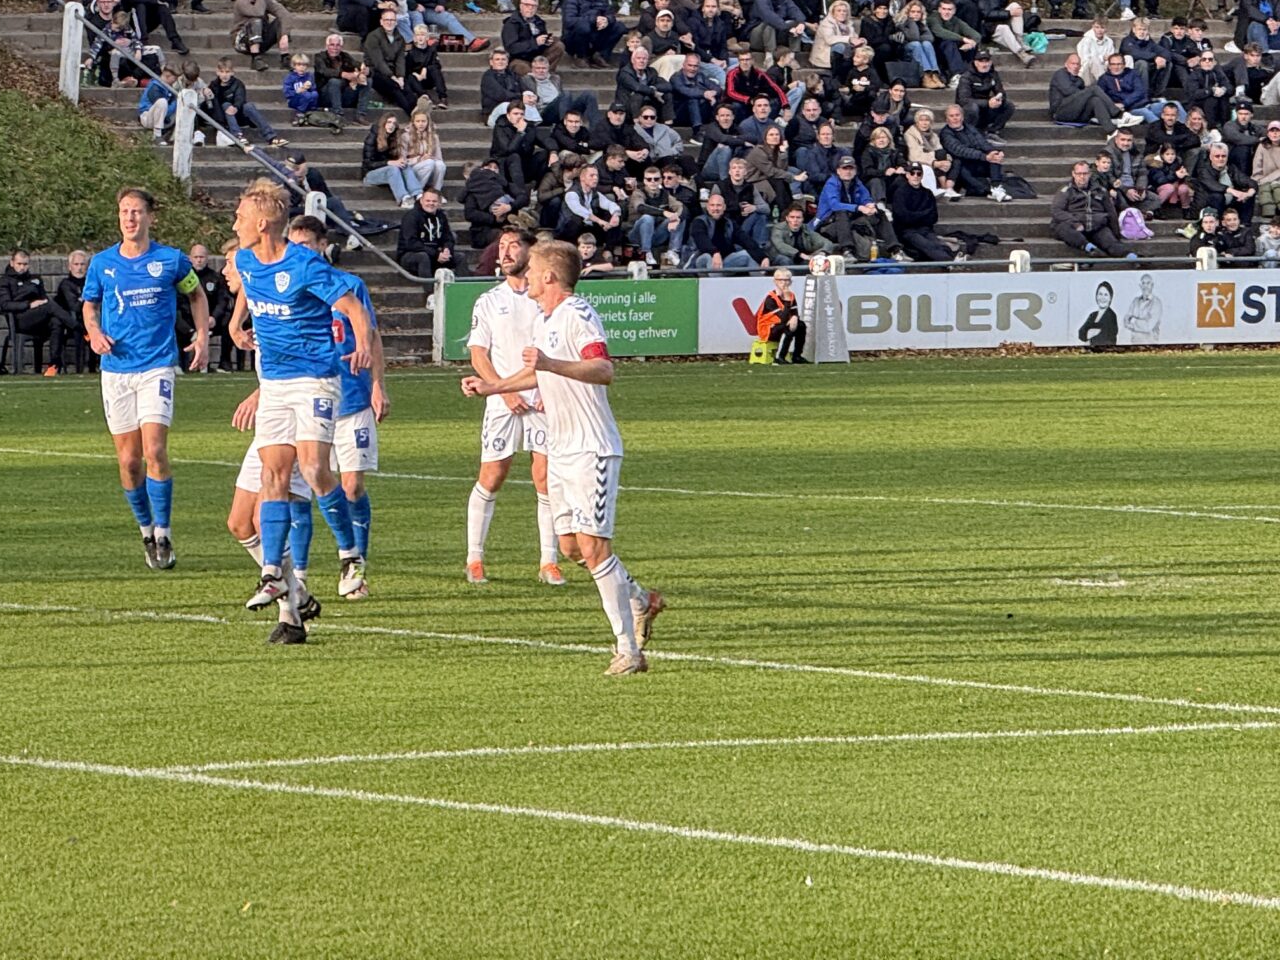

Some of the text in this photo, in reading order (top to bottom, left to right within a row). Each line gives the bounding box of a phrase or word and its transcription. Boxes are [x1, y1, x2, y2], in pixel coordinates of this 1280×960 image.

[633, 292, 637, 304] i
[638, 291, 657, 304] alle
[598, 309, 654, 321] eriets faser
[847, 292, 1043, 334] BILER
[622, 329, 637, 342] og
[639, 326, 678, 339] erhverv
[525, 427, 546, 446] 10
